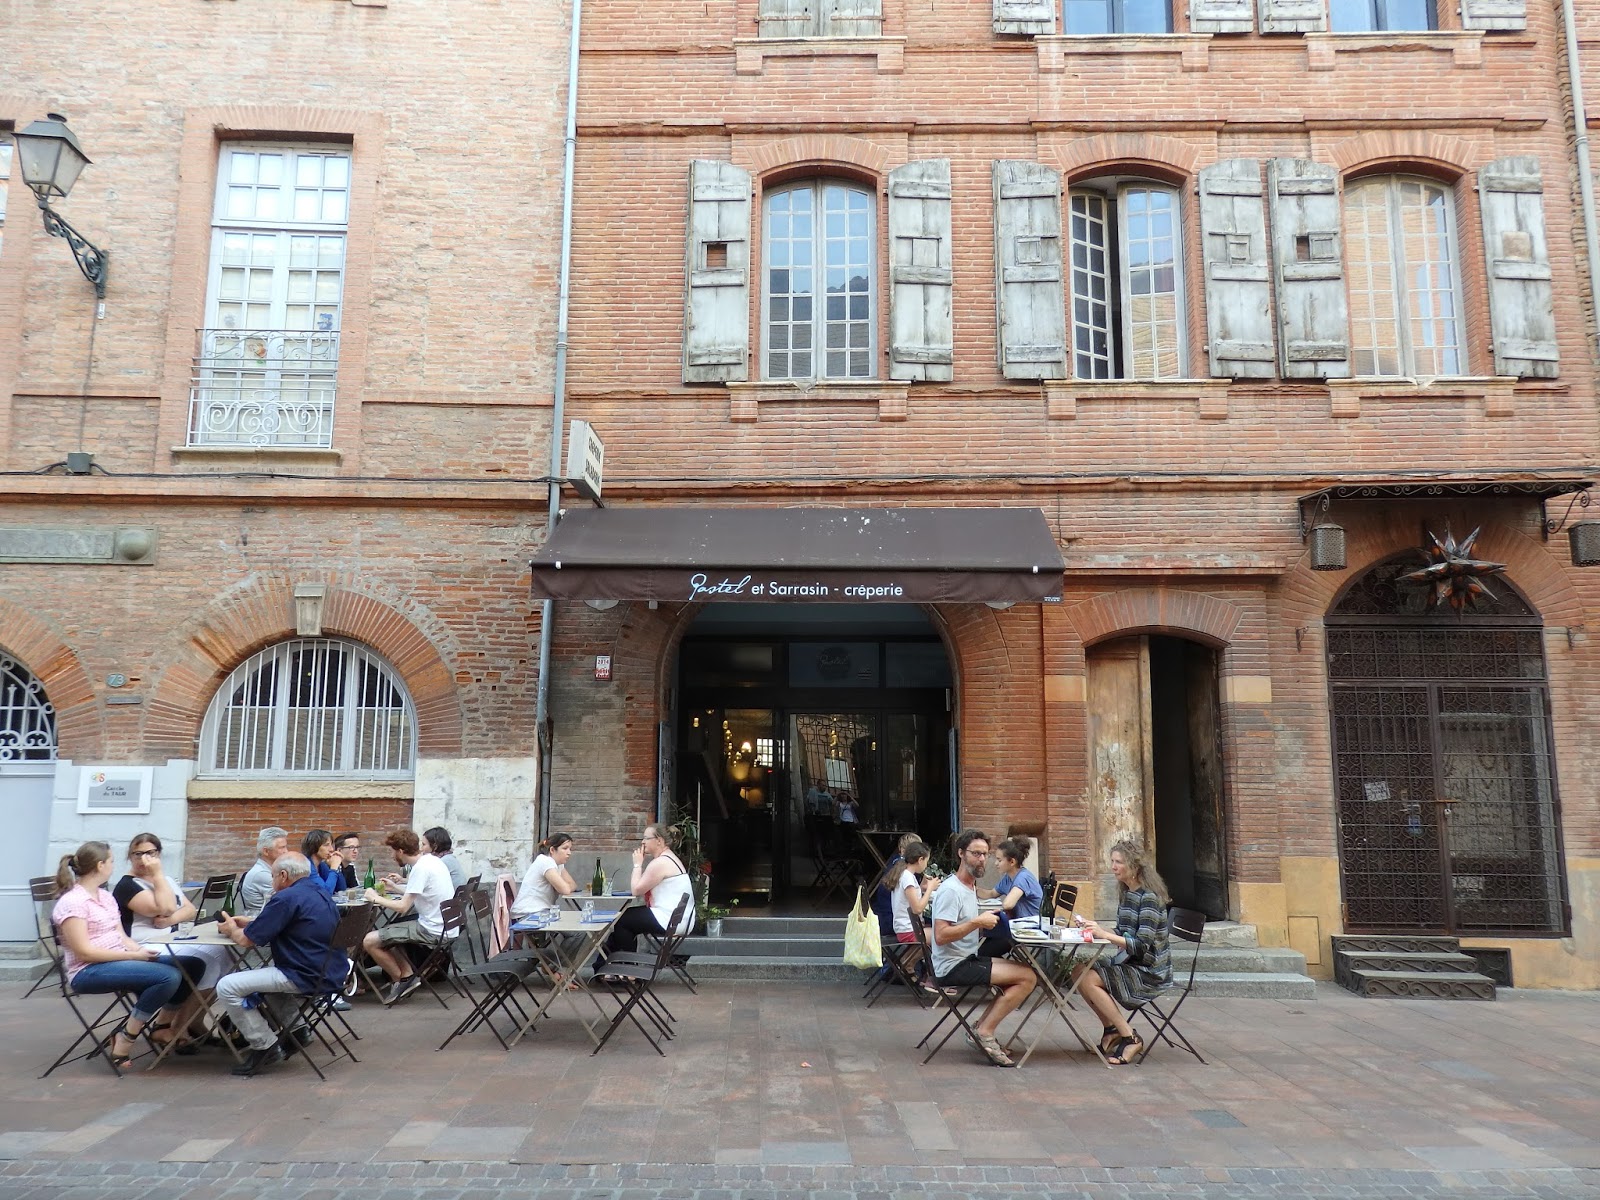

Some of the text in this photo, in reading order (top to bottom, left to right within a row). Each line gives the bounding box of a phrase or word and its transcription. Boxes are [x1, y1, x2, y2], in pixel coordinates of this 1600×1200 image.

[688, 573, 752, 600] Pastel
[751, 582, 765, 595] et
[769, 581, 829, 596] Sarrasin
[844, 583, 903, 600] crêperie
[110, 674, 124, 685] 73
